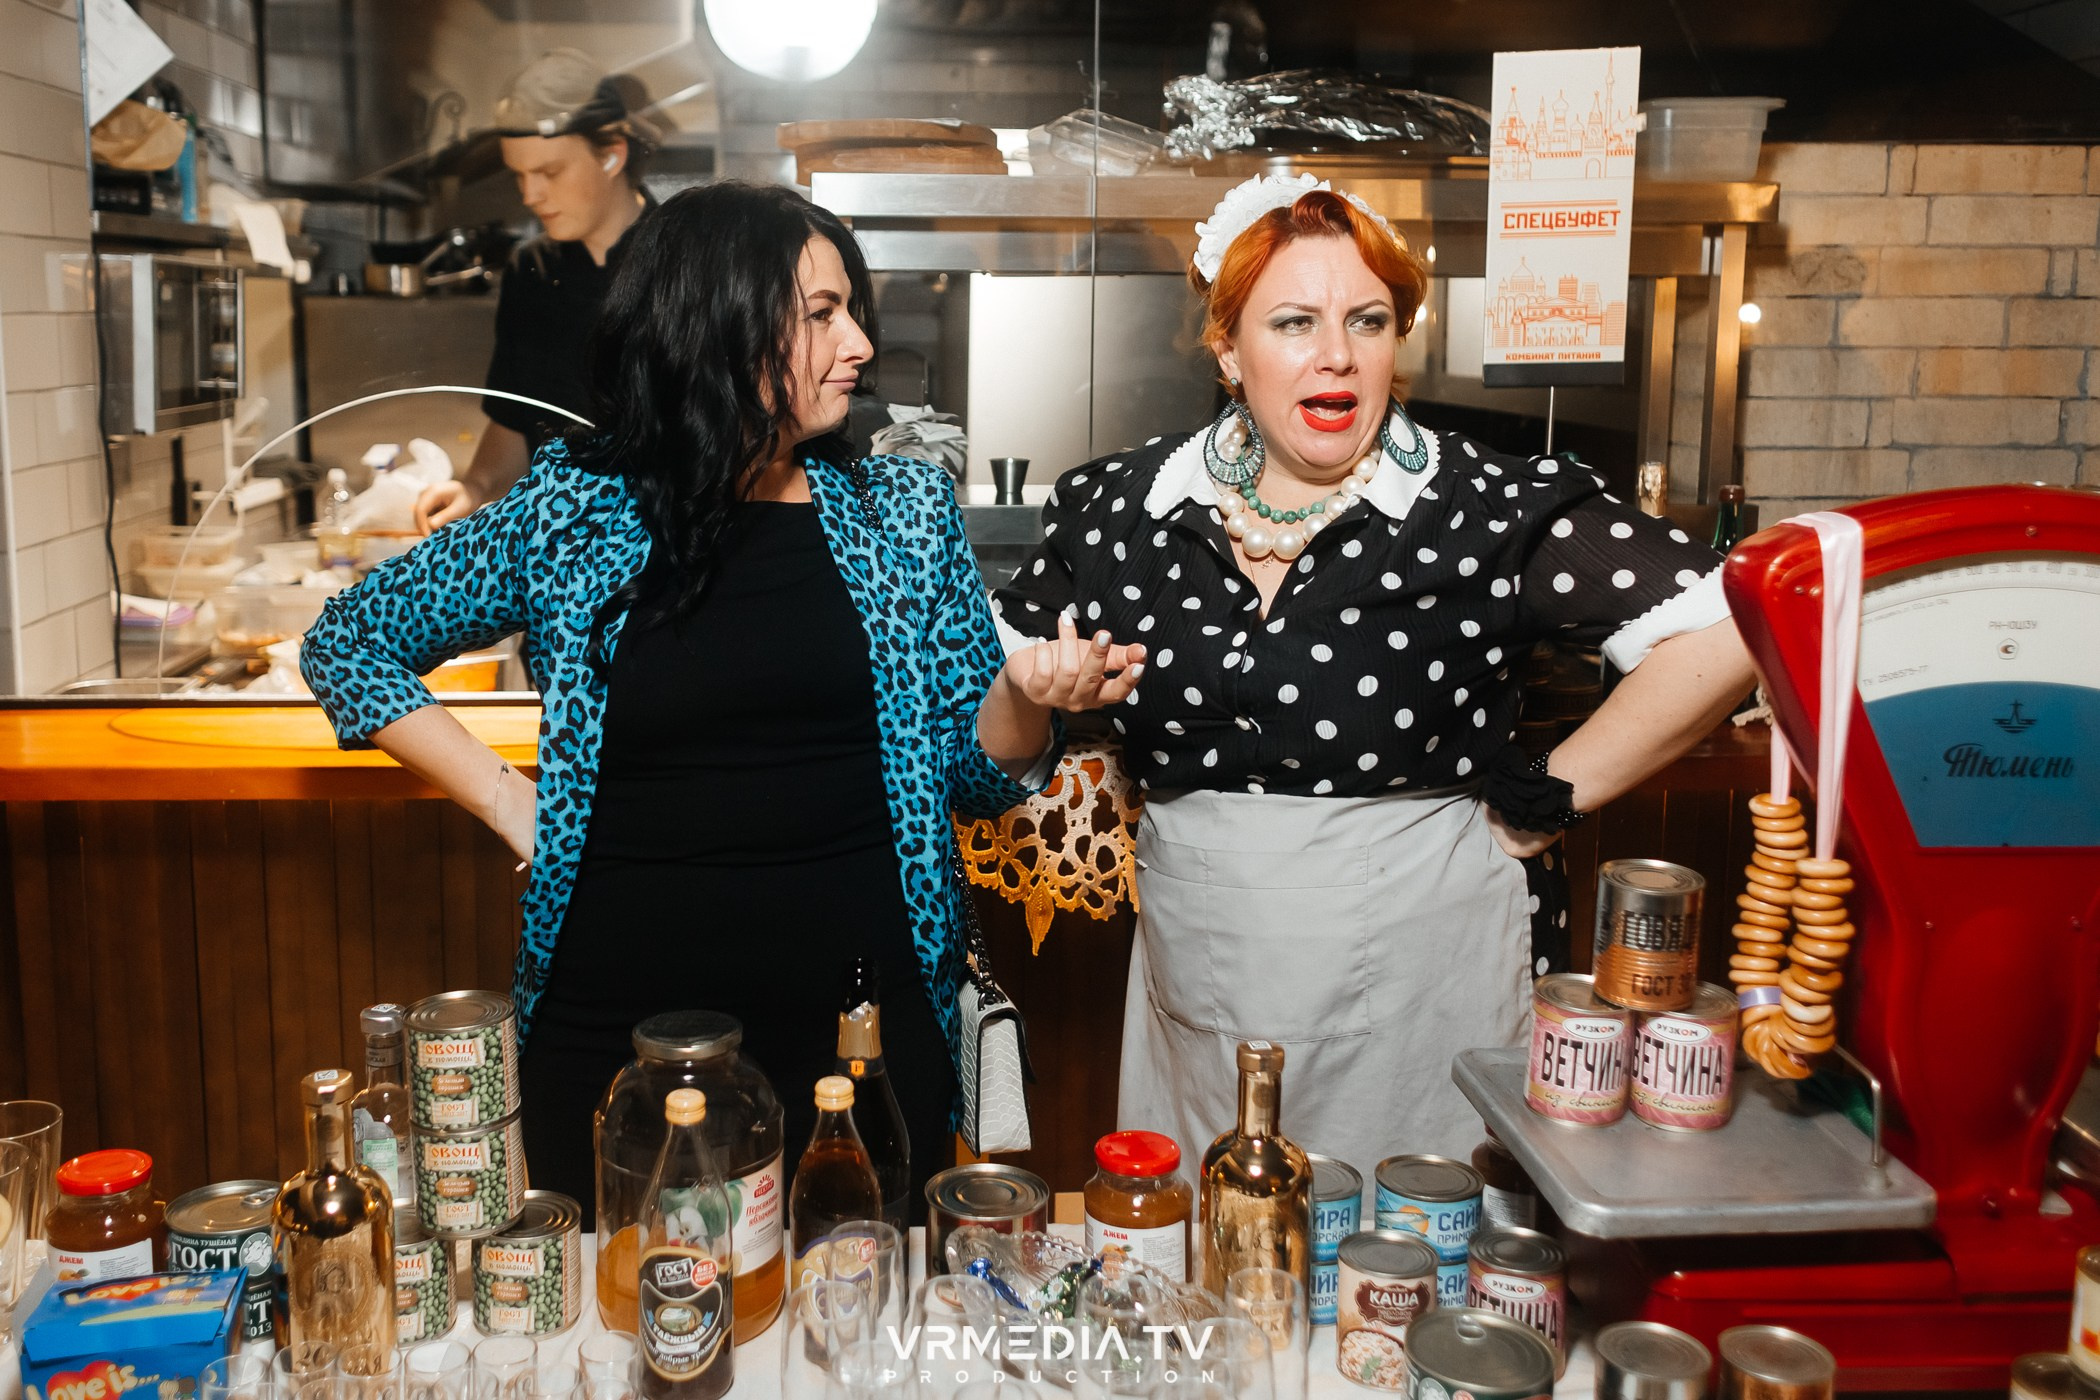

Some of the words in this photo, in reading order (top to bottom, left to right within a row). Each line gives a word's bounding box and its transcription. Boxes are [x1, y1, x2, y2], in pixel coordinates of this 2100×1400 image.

[1503, 210, 1621, 230] СПЕЦБУФЕТ
[1505, 352, 1555, 361] КОМБИНАТ
[1558, 351, 1601, 360] ПИТАНИЯ
[1943, 743, 2074, 778] Тюмень
[1631, 973, 1674, 996] ГОСТ
[1575, 1024, 1615, 1033] РУЗКОМ
[1656, 1023, 1699, 1036] РУЗКОМ
[425, 1044, 474, 1056] ОВОЩ
[1631, 1028, 1723, 1096] ВЕТЧИНА
[431, 1147, 480, 1159] ОВОЩ
[1103, 1229, 1128, 1240] ДЖЕМ
[1437, 1229, 1474, 1244] ПРИМО
[200, 1238, 237, 1247] ТУШЁНАЯ
[58, 1255, 84, 1265] ДЖЕМ
[172, 1242, 238, 1273] ГОСТ
[396, 1258, 422, 1270] ОЩ
[487, 1250, 533, 1265] ОВОЩ
[658, 1262, 689, 1277] ГОСТ
[697, 1263, 713, 1273] БЕЗ
[1492, 1279, 1534, 1294] РУЗКОМ
[1369, 1289, 1419, 1307] КАША
[250, 1322, 272, 1336] 013
